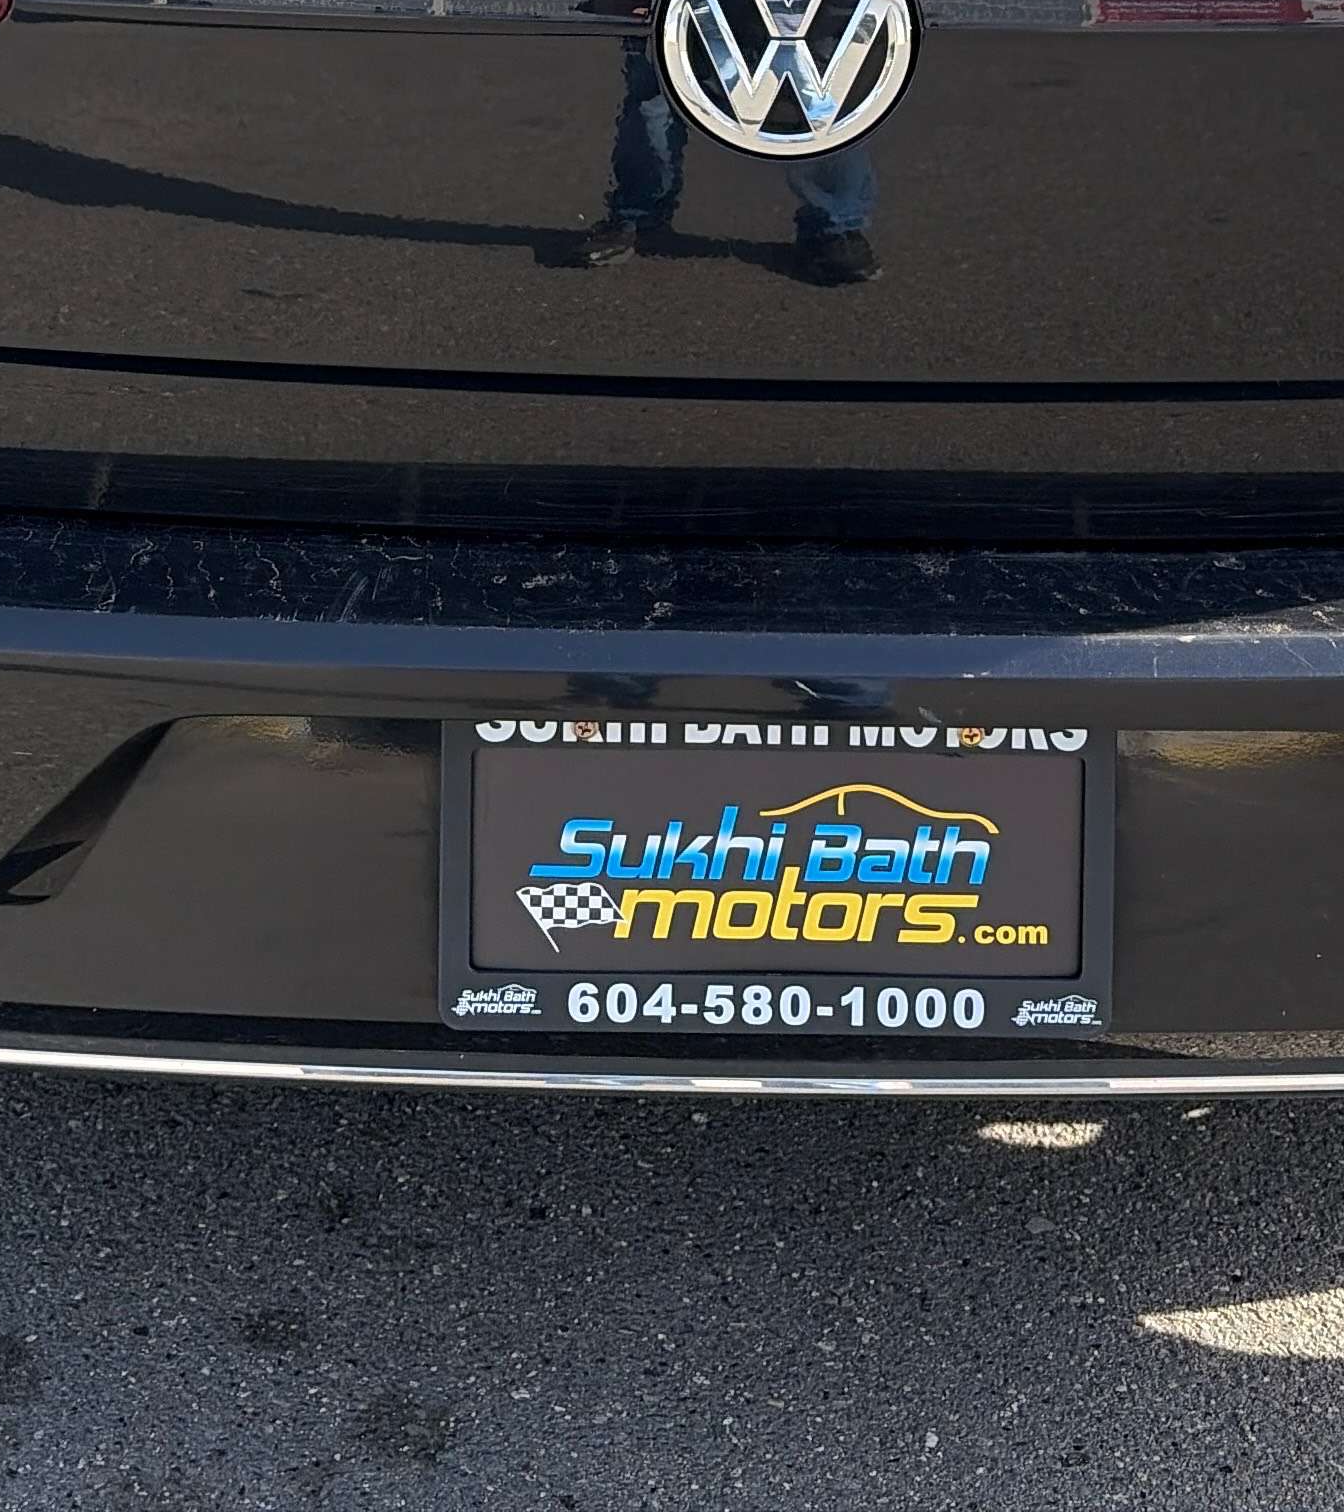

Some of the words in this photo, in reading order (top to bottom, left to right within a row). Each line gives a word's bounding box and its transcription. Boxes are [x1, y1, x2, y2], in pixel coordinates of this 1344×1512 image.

[529, 806, 787, 880] Sukhi
[804, 824, 990, 884] Bath
[458, 989, 501, 1002] Sukhi
[504, 990, 536, 1003] Bath
[567, 983, 985, 1029] 604-580-1000
[1018, 999, 1061, 1012] Sukhi
[1064, 1001, 1097, 1013] Bath
